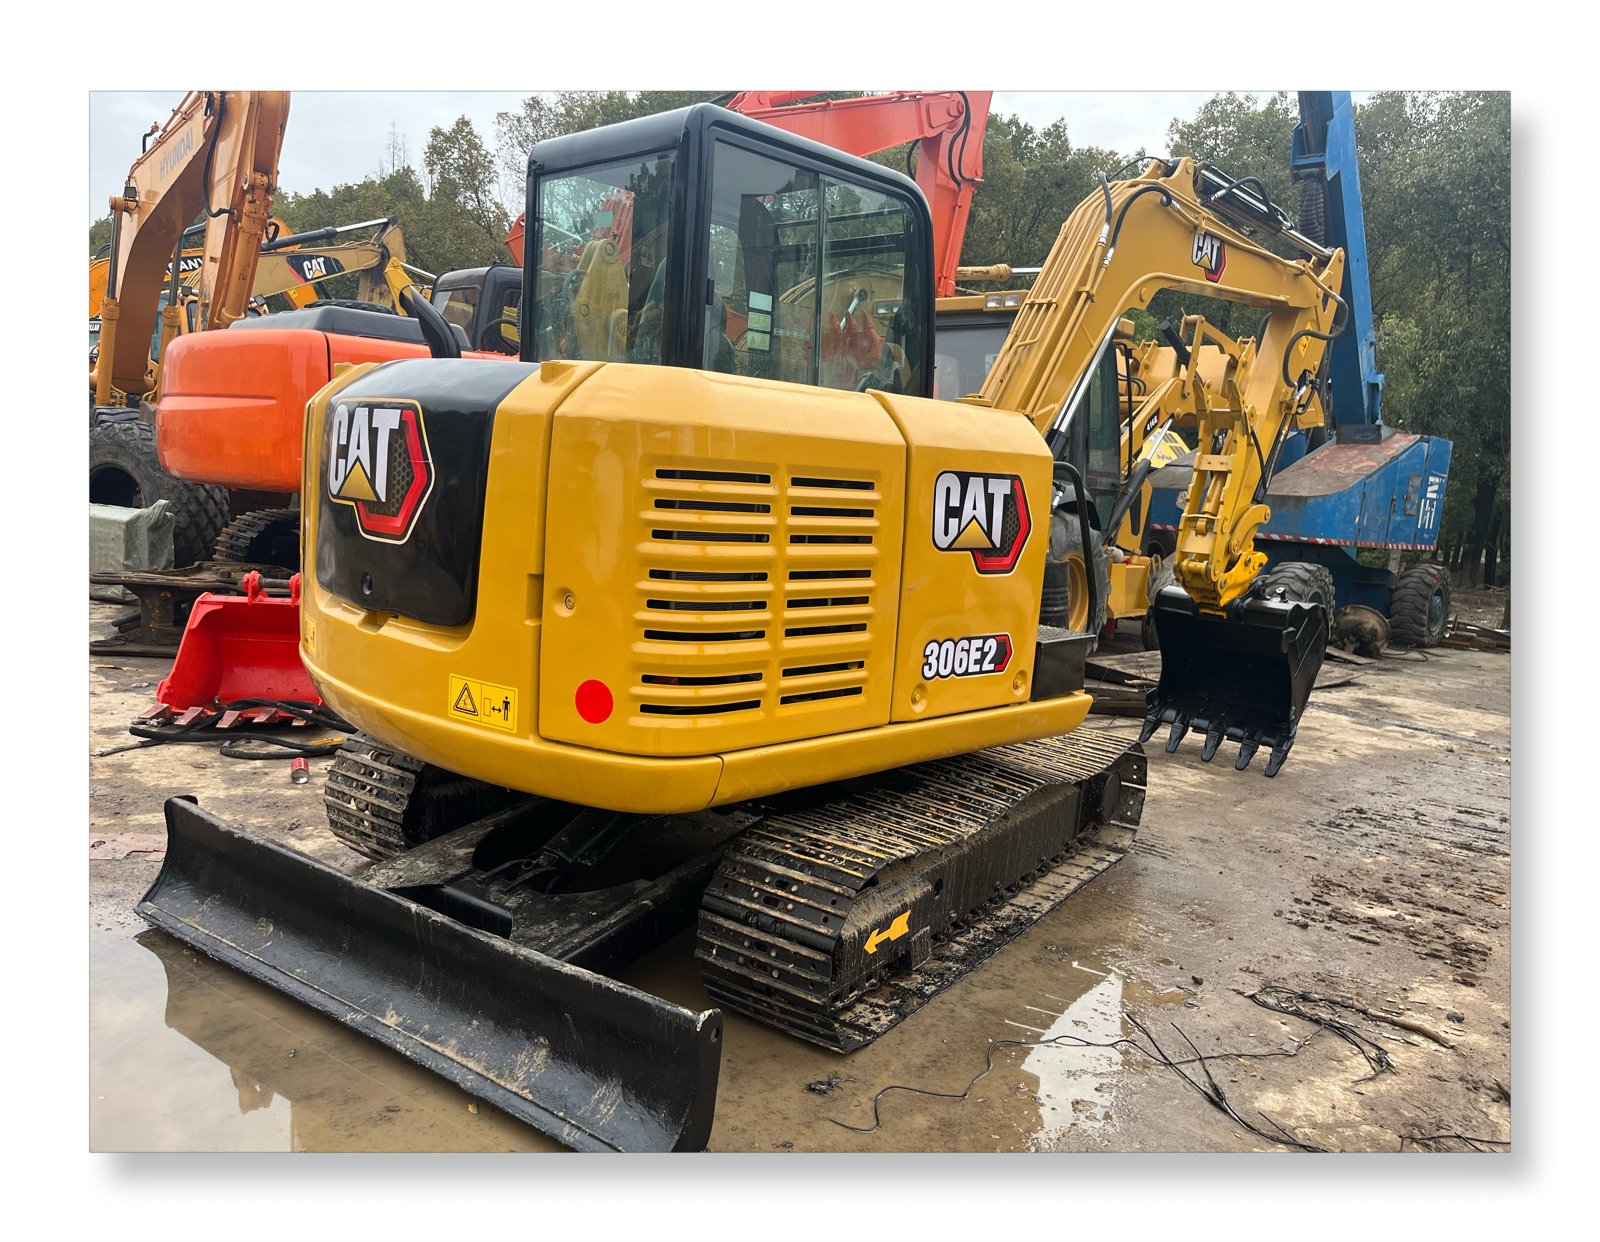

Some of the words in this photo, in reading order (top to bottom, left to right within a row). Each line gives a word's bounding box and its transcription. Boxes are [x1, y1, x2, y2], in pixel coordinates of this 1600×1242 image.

[160, 128, 193, 181] HYUNDAI
[303, 257, 327, 280] CAT
[1193, 232, 1220, 270] CAT
[329, 404, 401, 503] CAT
[934, 472, 1011, 549] CAT
[923, 637, 997, 678] 306E2
